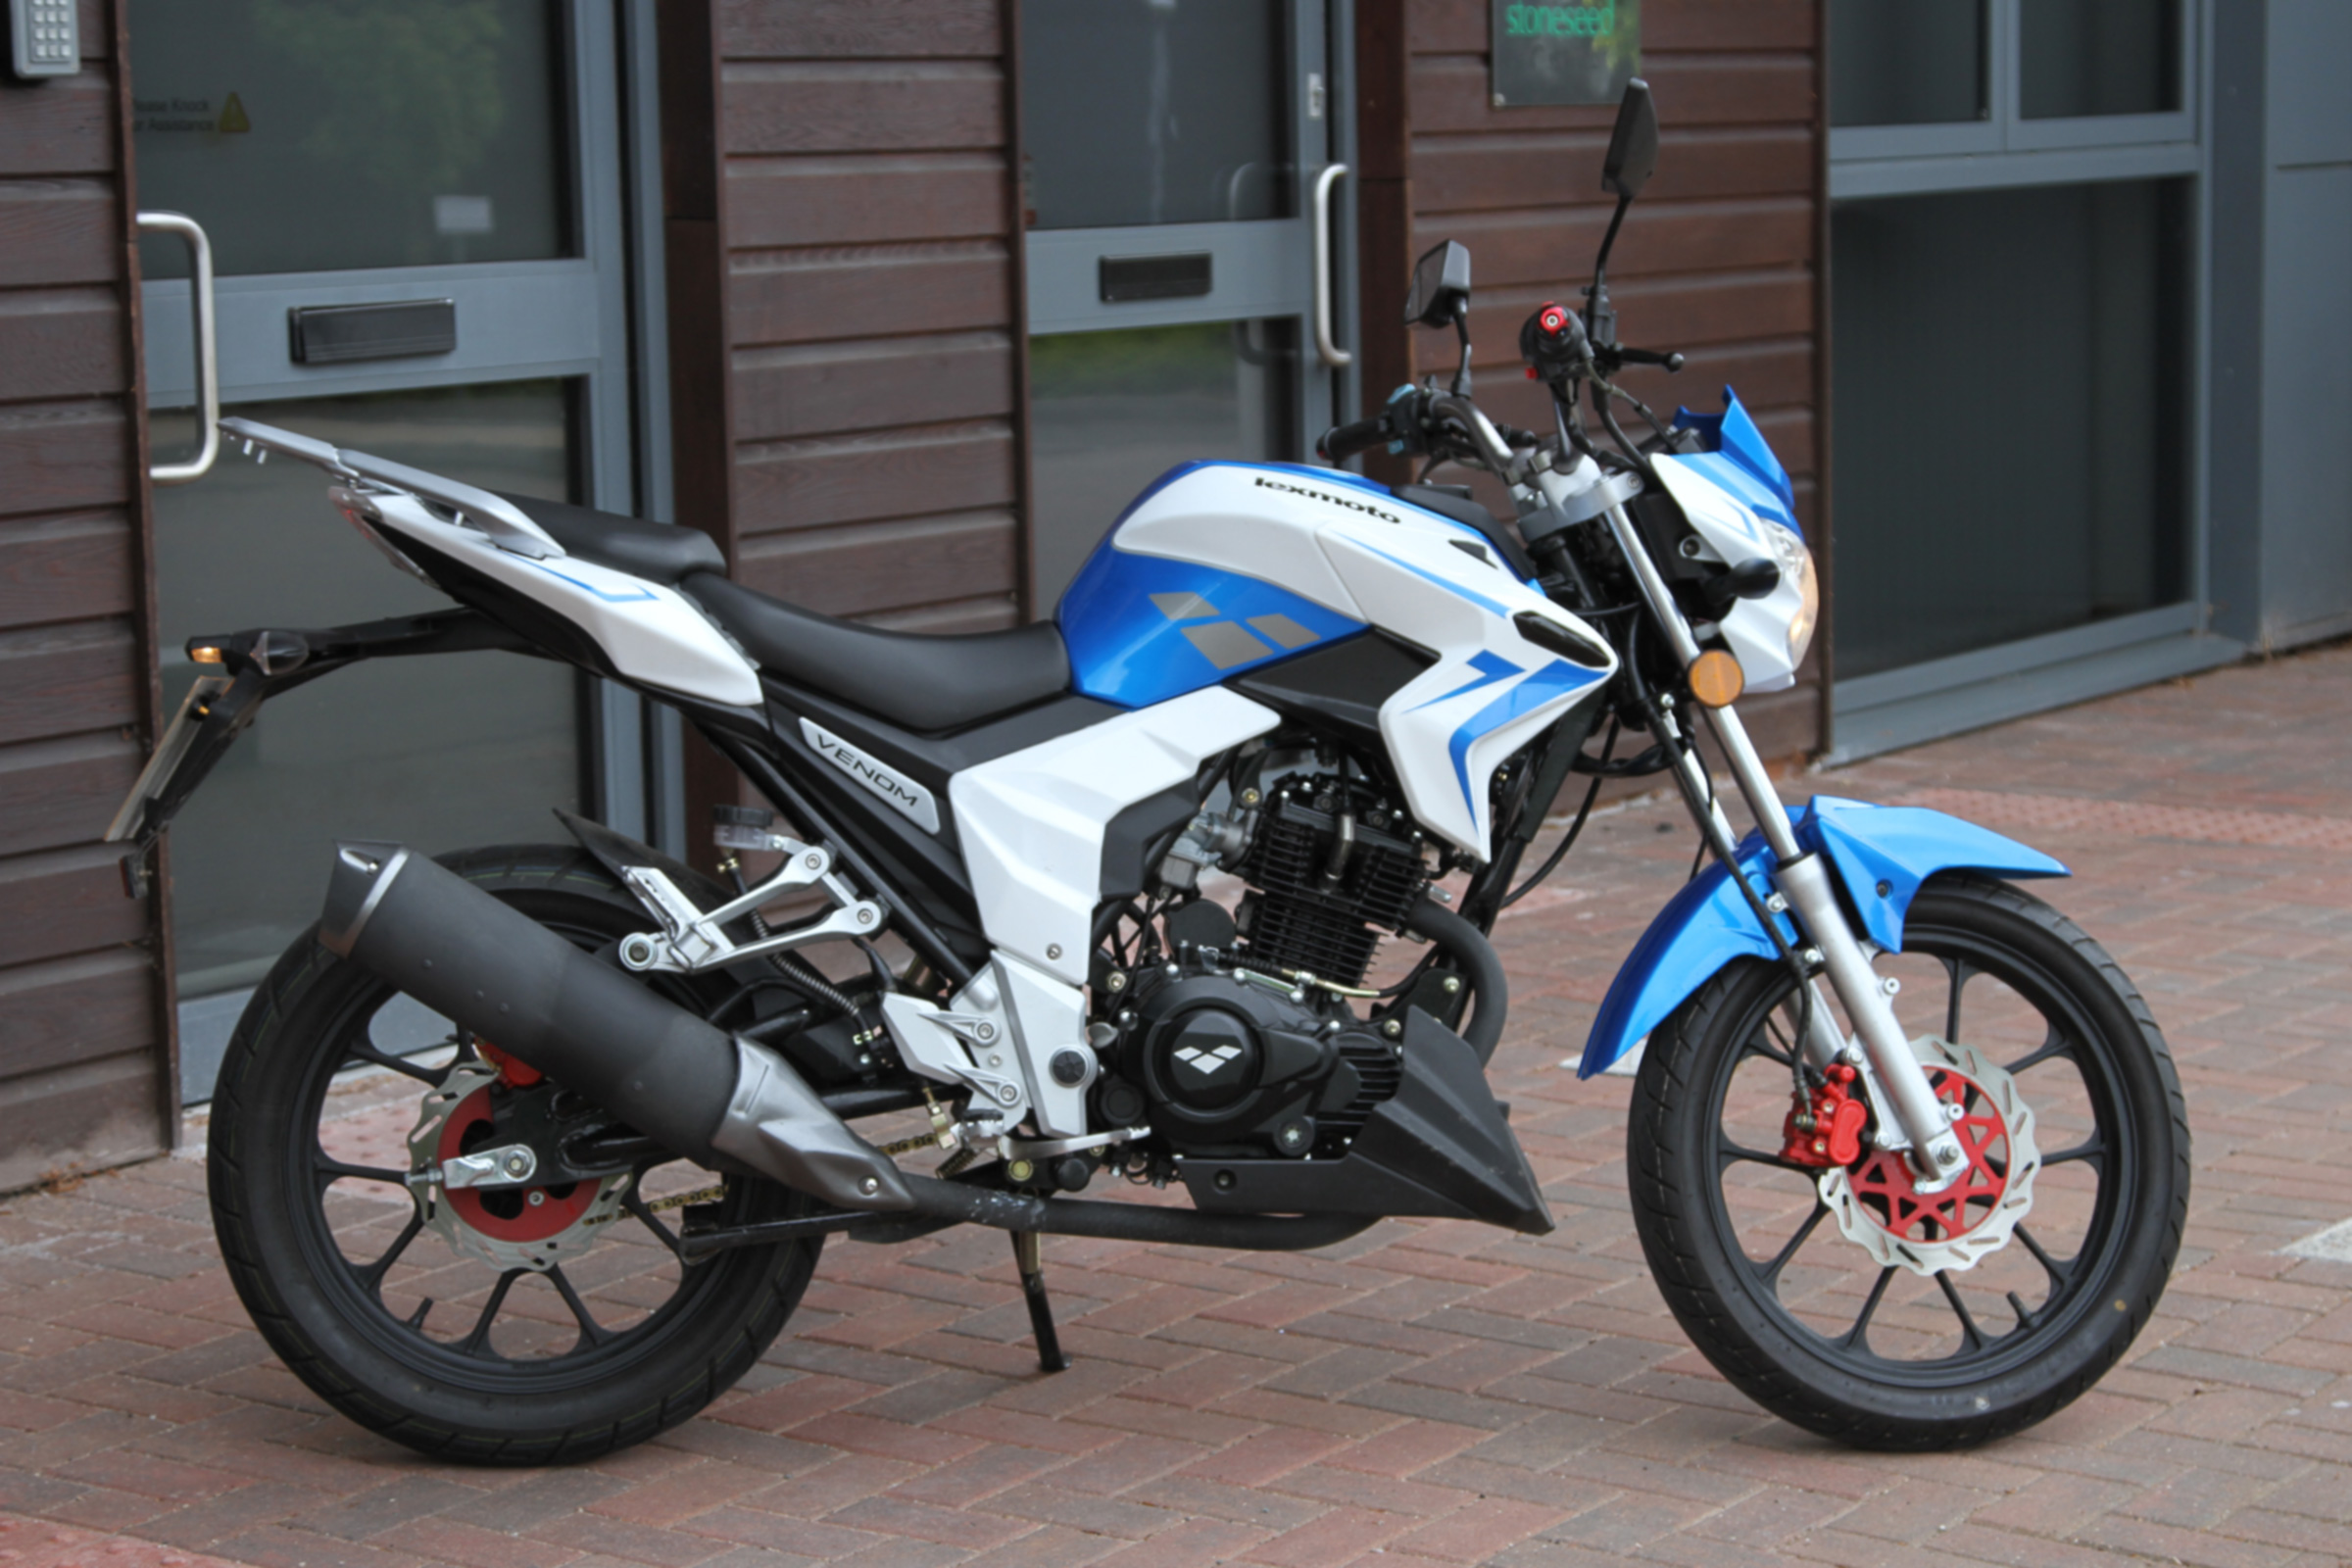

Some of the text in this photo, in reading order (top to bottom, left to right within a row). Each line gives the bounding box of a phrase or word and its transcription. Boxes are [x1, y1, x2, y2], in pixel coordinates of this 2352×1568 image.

[1506, 0, 1615, 35] stoneseed
[133, 98, 167, 112] lease
[133, 119, 145, 131] or
[1254, 476, 1401, 524] lexmoto
[817, 733, 918, 808] VENOM
